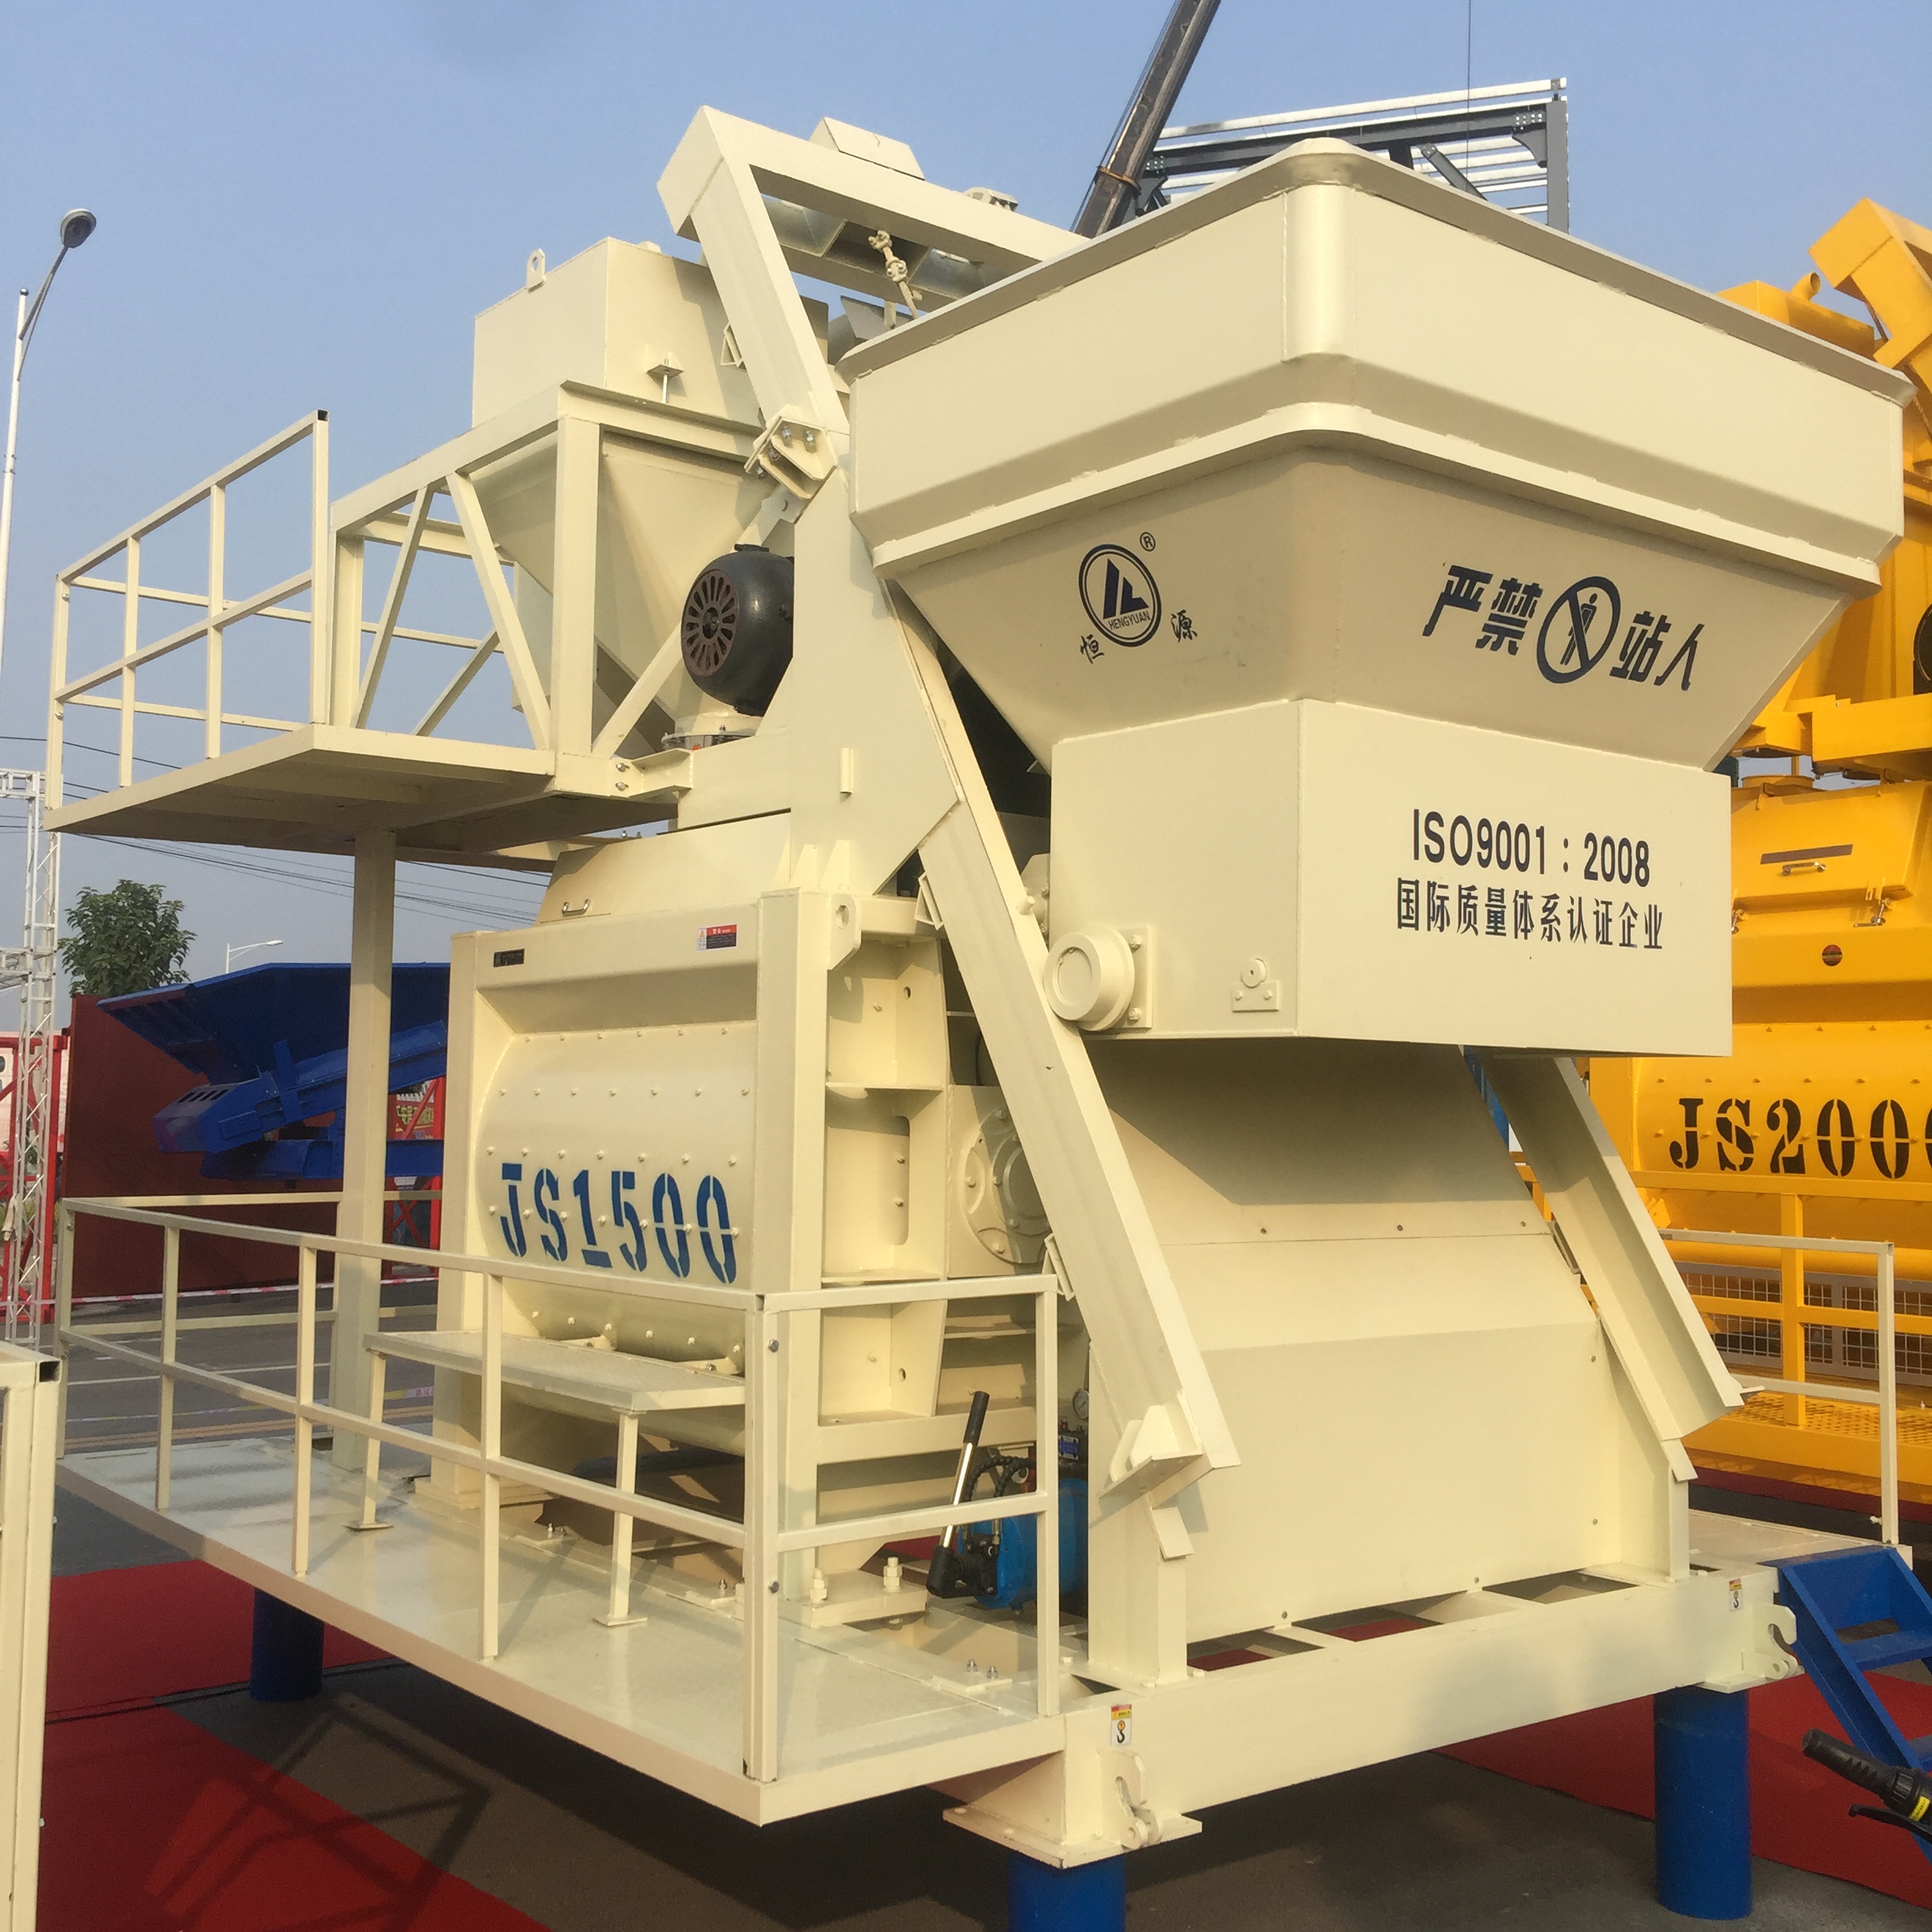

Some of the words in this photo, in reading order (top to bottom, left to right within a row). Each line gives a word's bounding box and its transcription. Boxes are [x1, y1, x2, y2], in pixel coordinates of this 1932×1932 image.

[1108, 611, 1151, 631] HENGYUAN
[1422, 564, 1544, 656] 严禁
[1609, 610, 1705, 691] 站人
[1397, 878, 1662, 949] 国际质量体系认证企业
[1669, 1098, 1932, 1179] JS200
[500, 1163, 736, 1284] JS1500
